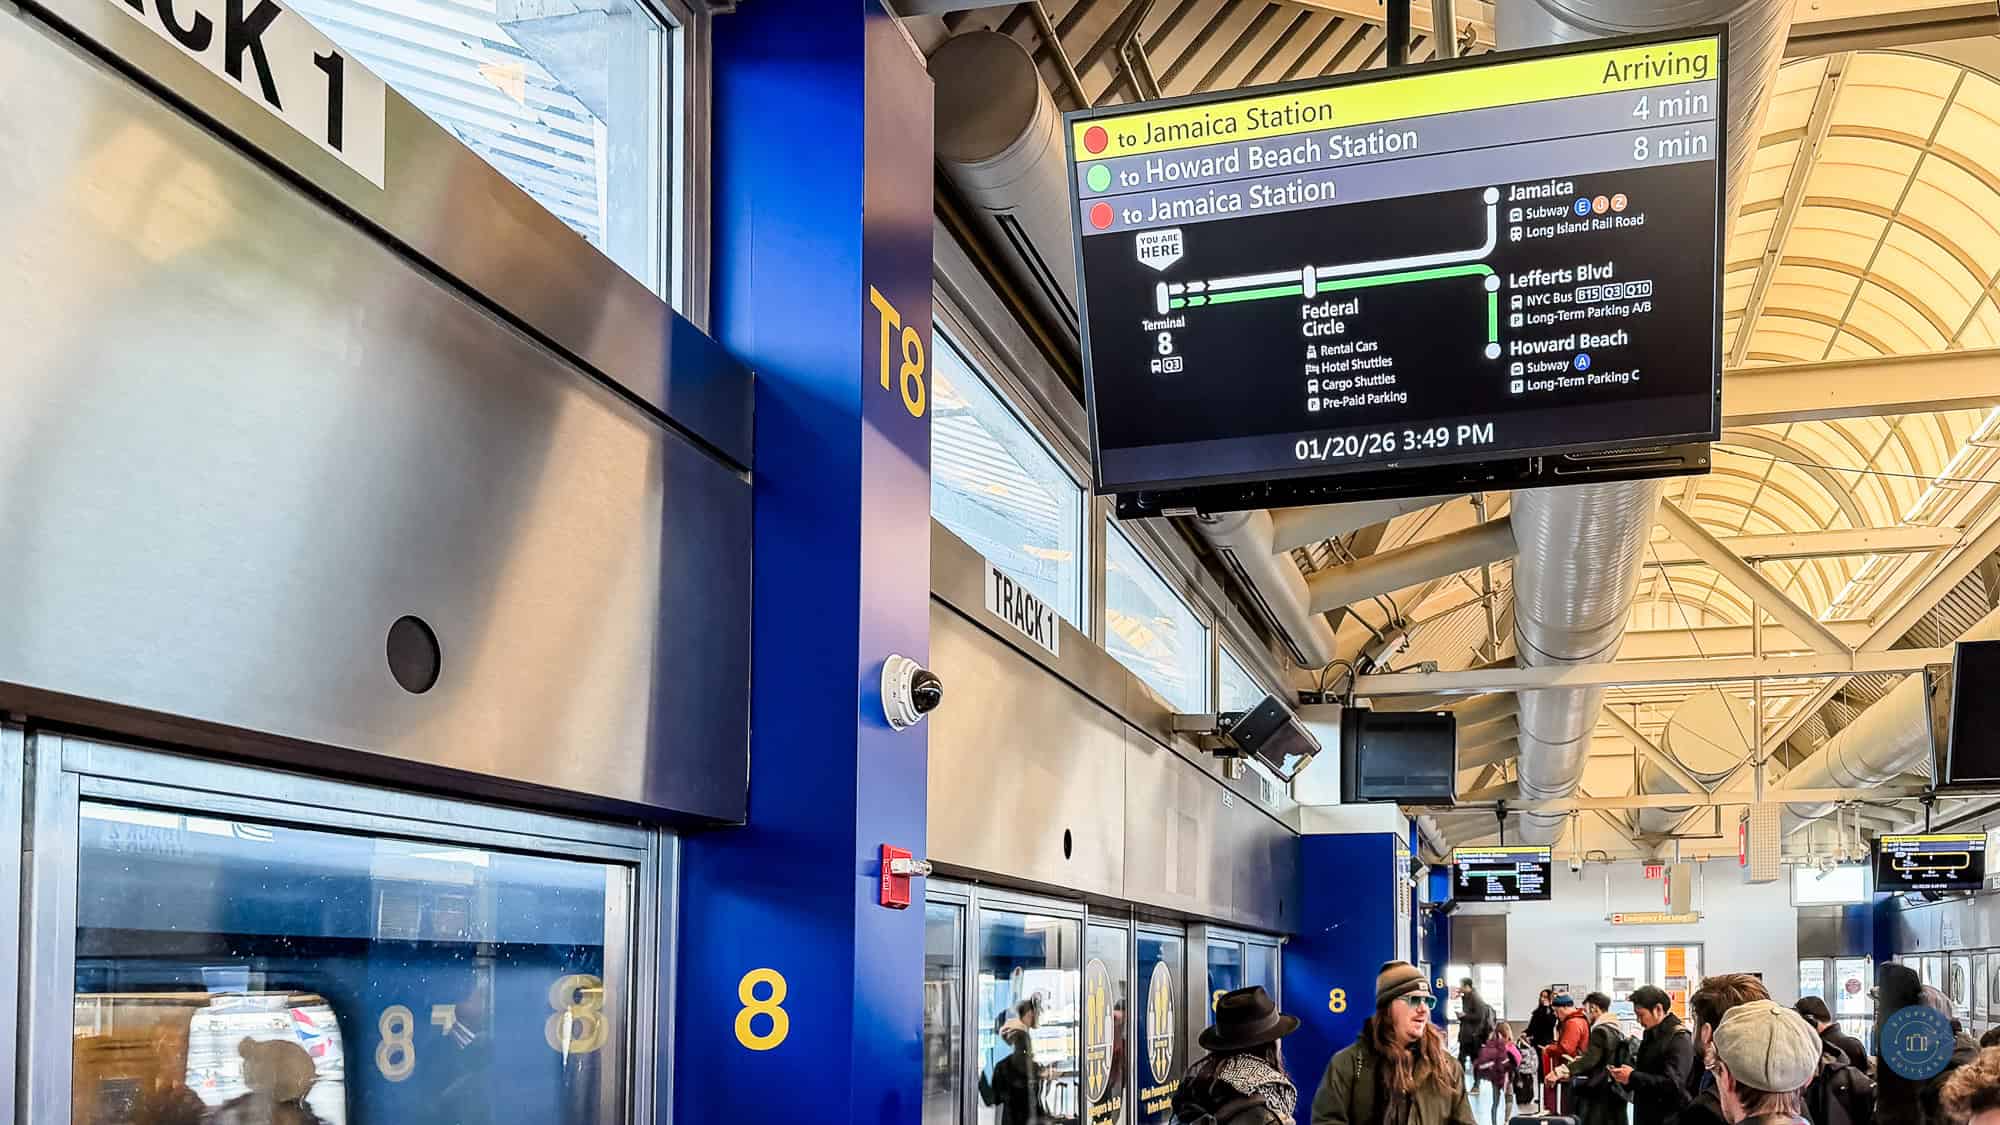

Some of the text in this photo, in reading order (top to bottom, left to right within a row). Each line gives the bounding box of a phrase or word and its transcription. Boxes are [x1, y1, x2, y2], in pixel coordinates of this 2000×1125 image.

[124, 0, 343, 152] CK 1
[1602, 51, 1708, 84] Arriving
[1632, 90, 1708, 121] 4 min
[1118, 102, 1333, 147] to Jamaica Station
[1120, 128, 1418, 187] to Howard Beach Station
[1633, 131, 1707, 161] 8 min
[1122, 179, 1336, 225] to Jamaica Station
[1508, 180, 1574, 201] Jamaica
[1526, 205, 1570, 220] Subway
[1526, 213, 1644, 239] Long Island Rail Road
[1140, 233, 1178, 245] YOU ARE
[1141, 243, 1180, 258] HERE
[1510, 261, 1613, 289] Lefferts Blvd
[1302, 297, 1359, 320] Federal
[1527, 293, 1550, 306] NYC
[1553, 292, 1573, 304] Bus
[1142, 315, 1186, 331] Terminal
[1527, 301, 1651, 325] Long-Term Parking A/B
[1302, 318, 1345, 337] Circle
[870, 284, 926, 417] T8
[1157, 331, 1173, 355] 8
[1320, 341, 1378, 356] Rental Cars
[1510, 329, 1628, 356] Howard Beach
[1321, 355, 1393, 373] Hotel Shuttles
[1527, 359, 1570, 373] Subway
[1322, 373, 1396, 391] Cargo Shuttles
[1527, 369, 1641, 391] Long-Term Parking C
[1323, 390, 1408, 409] Pre-Paid Parking
[1295, 422, 1494, 461] 01/20/26 3:49 PM
[993, 566, 1055, 651] TRACK 1
[1435, 977, 1445, 989] 8
[734, 967, 790, 1051] 8
[1329, 988, 1347, 1013] 8
